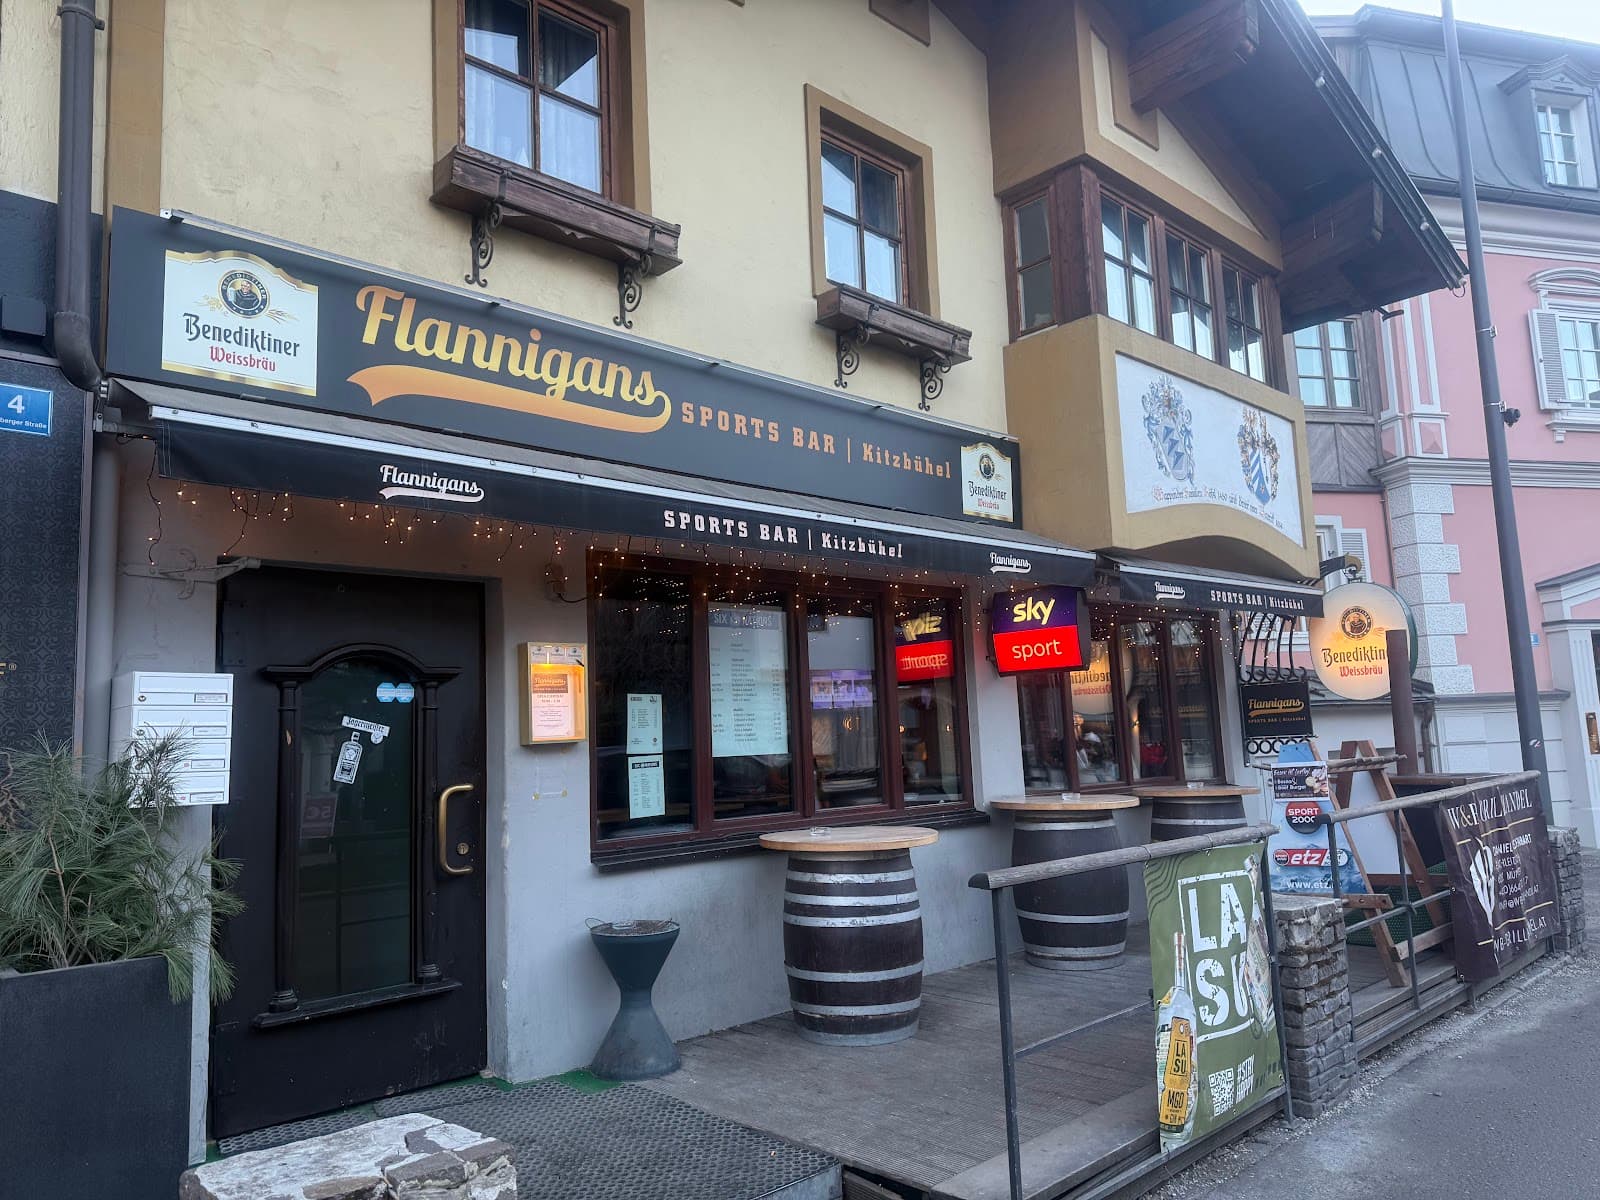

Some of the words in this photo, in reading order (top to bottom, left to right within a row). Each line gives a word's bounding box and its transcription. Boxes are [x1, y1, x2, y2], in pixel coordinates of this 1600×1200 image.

[183, 313, 300, 357] Benediktiner
[356, 285, 660, 405] Flannigans
[209, 346, 276, 372] Weissbräu
[8, 394, 25, 414] 4
[25, 420, 47, 429] Straße
[681, 401, 780, 443] SPORTS
[793, 426, 836, 454] BAR
[863, 442, 951, 479] Kitzbühel
[380, 464, 481, 495] Flannigans
[968, 481, 1007, 500] Benediktiner
[664, 509, 748, 538] SPORTS
[760, 523, 798, 544] BAR
[821, 532, 903, 559] Kitzbühel
[990, 551, 1030, 569] Flannigans
[1155, 581, 1184, 595] Flannigans
[1210, 590, 1244, 604] SPORTS
[1246, 595, 1262, 606] BAR
[1268, 597, 1304, 610] Kitzbühel
[1013, 596, 1055, 625] sky
[1011, 639, 1062, 662] sport
[1322, 646, 1387, 668] Benediktin
[1339, 665, 1383, 678] Weissbräu
[1248, 698, 1302, 710] Flannigans
[1288, 808, 1319, 816] SPORT
[1290, 849, 1322, 865] etz
[1188, 882, 1247, 952] LA
[1175, 1041, 1187, 1057] LA
[1173, 1058, 1187, 1075] SU
